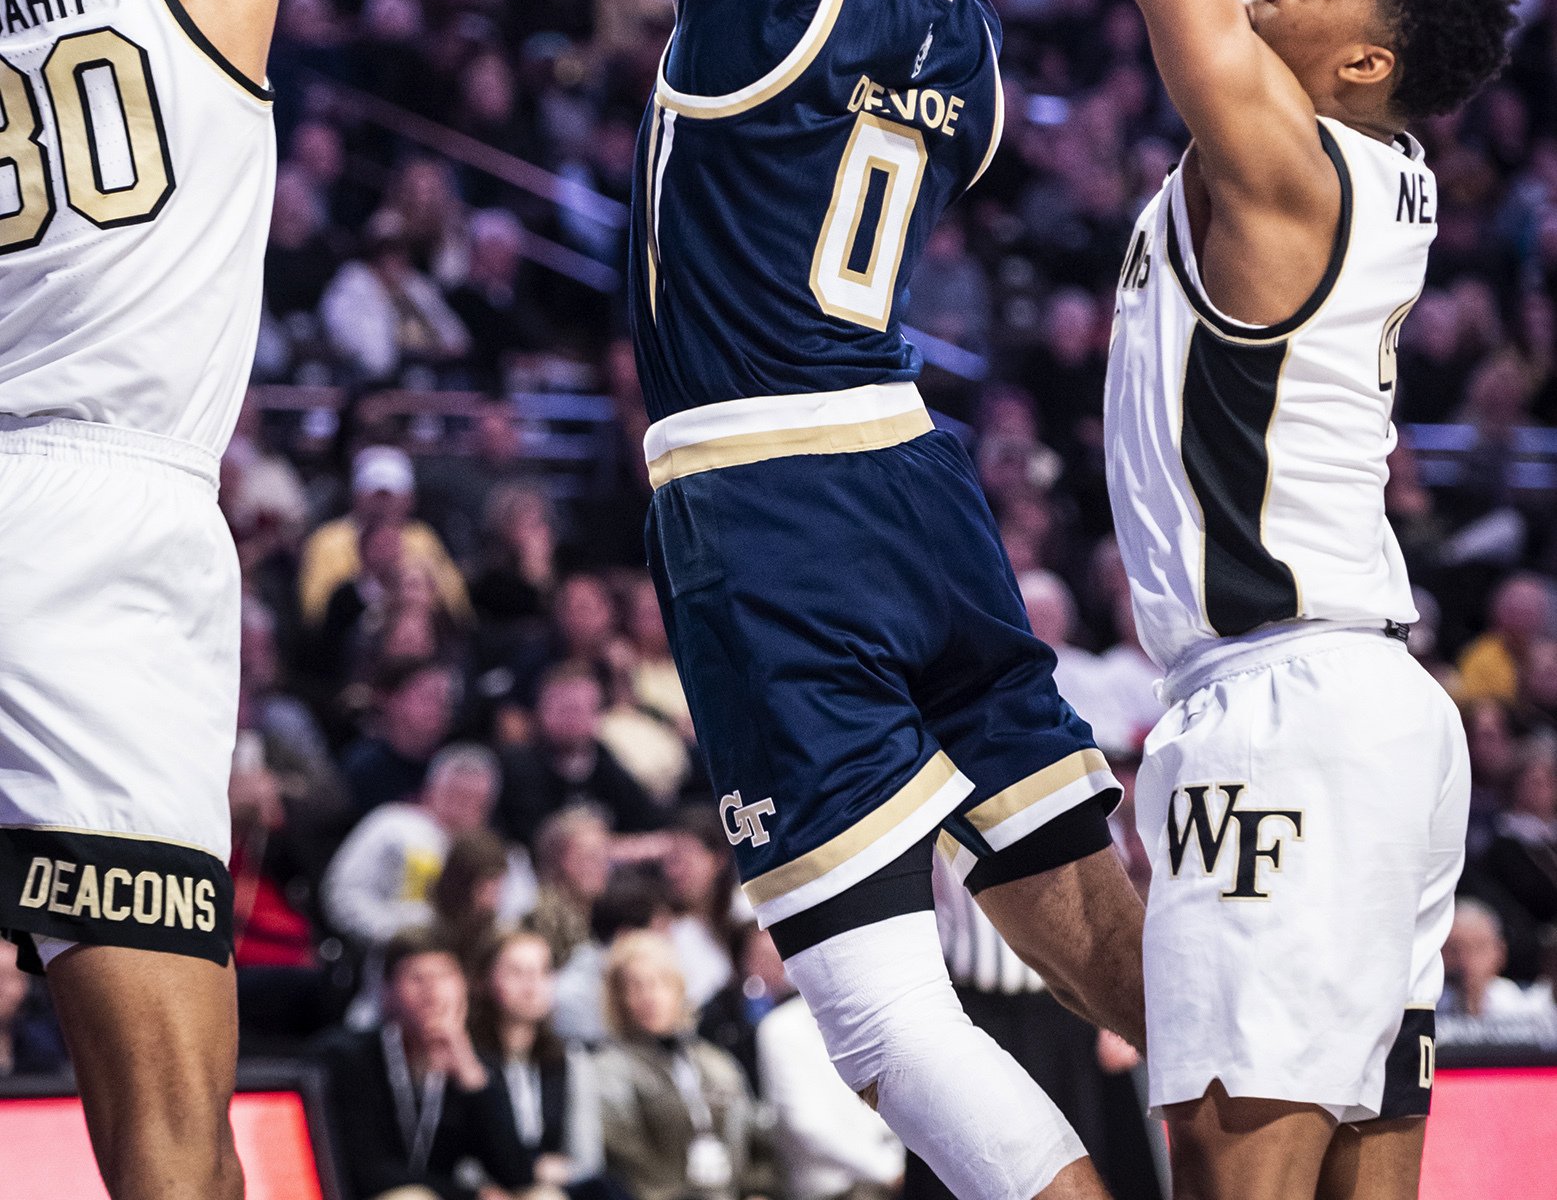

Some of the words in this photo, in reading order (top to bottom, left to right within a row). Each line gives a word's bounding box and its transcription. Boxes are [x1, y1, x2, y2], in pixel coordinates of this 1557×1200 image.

[847, 74, 965, 137] DEVOE
[808, 110, 928, 333] 0
[1396, 171, 1438, 224] NE
[719, 789, 776, 848] GT
[1167, 781, 1305, 902] WF
[19, 856, 216, 932] DEACONS
